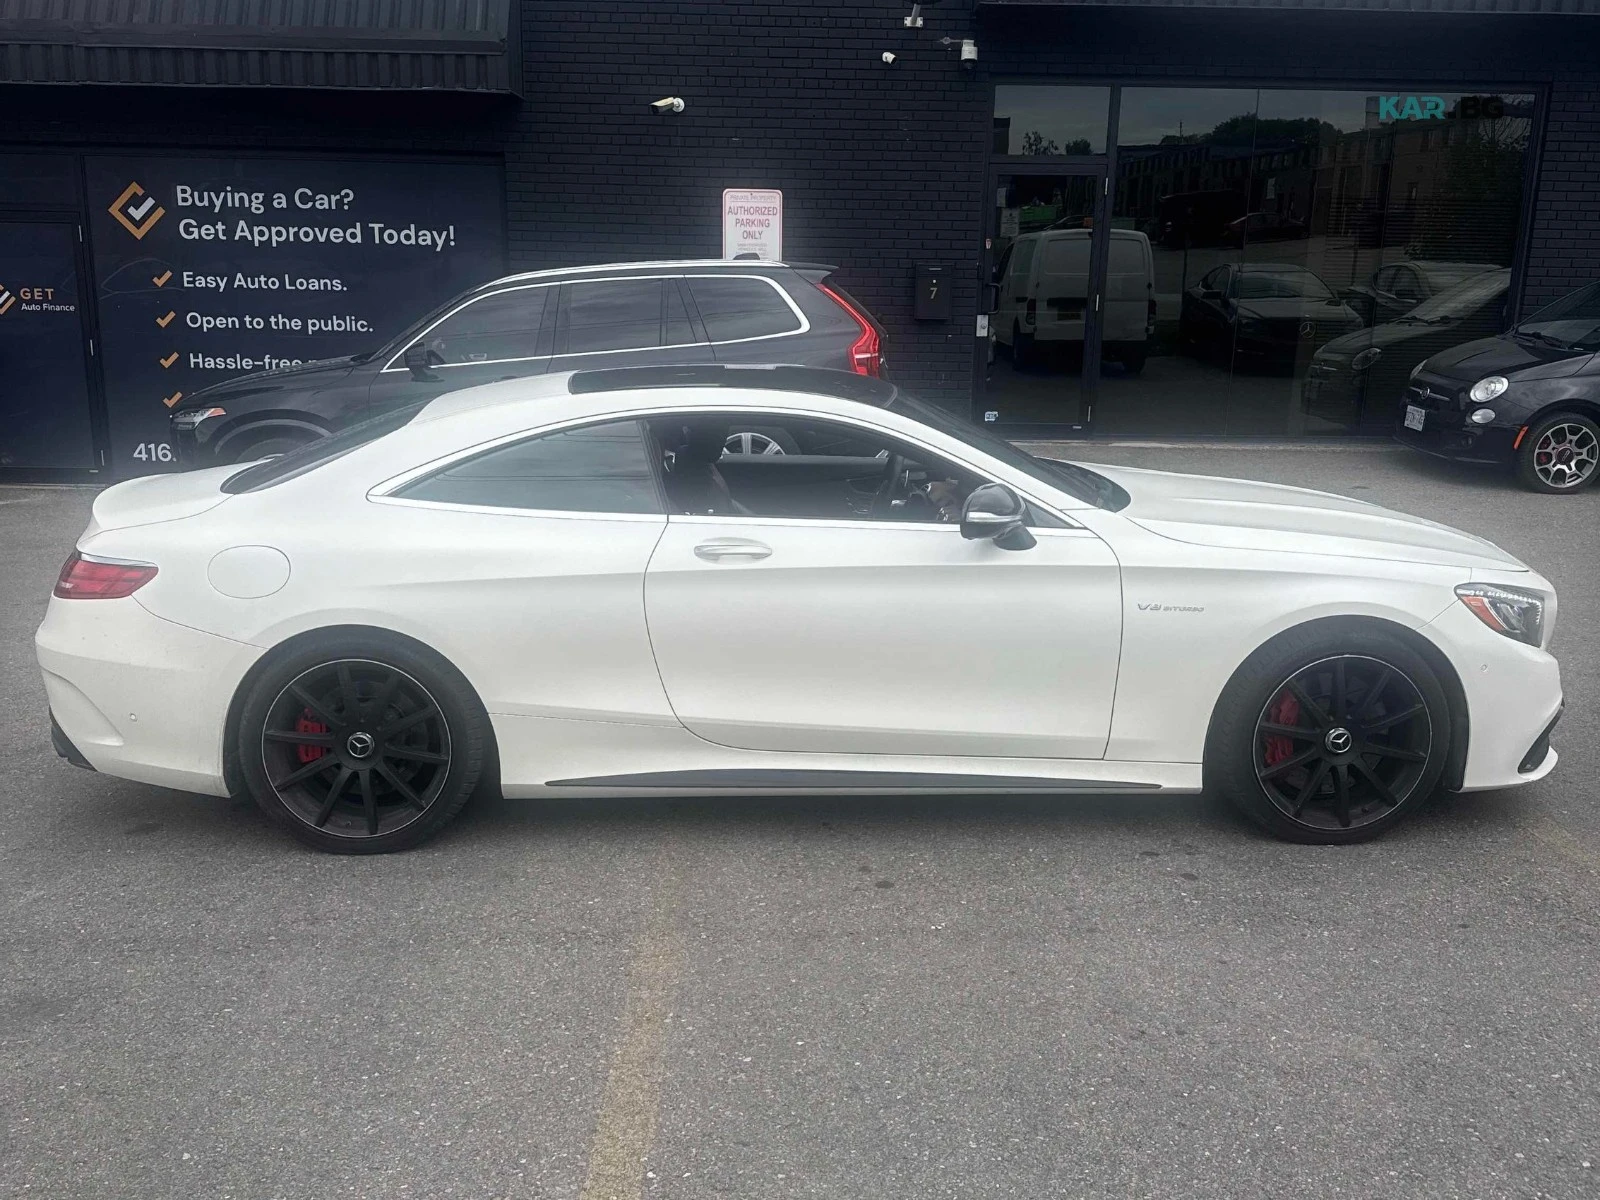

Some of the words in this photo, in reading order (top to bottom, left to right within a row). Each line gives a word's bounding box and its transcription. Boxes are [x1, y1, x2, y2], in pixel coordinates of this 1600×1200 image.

[176, 185, 265, 214] Buying
[272, 192, 287, 209] a
[294, 187, 354, 211] Car?
[727, 206, 778, 216] AUTHORIZED
[735, 218, 770, 228] PARKING
[179, 218, 227, 240] Get
[234, 220, 362, 247] Approved
[368, 222, 456, 252] Today!
[742, 230, 763, 240] ONLY
[183, 271, 227, 292] Easy
[233, 273, 280, 289] Auto
[284, 274, 348, 291] Loans.
[20, 287, 54, 300] GET
[929, 287, 938, 299] 7
[21, 303, 41, 311] Auto
[43, 303, 75, 312] Finance
[186, 312, 240, 332] Open
[244, 314, 265, 329] to
[269, 314, 302, 330] the
[307, 315, 374, 335] public.
[133, 443, 177, 461] 416.
[1137, 603, 1161, 611] V8
